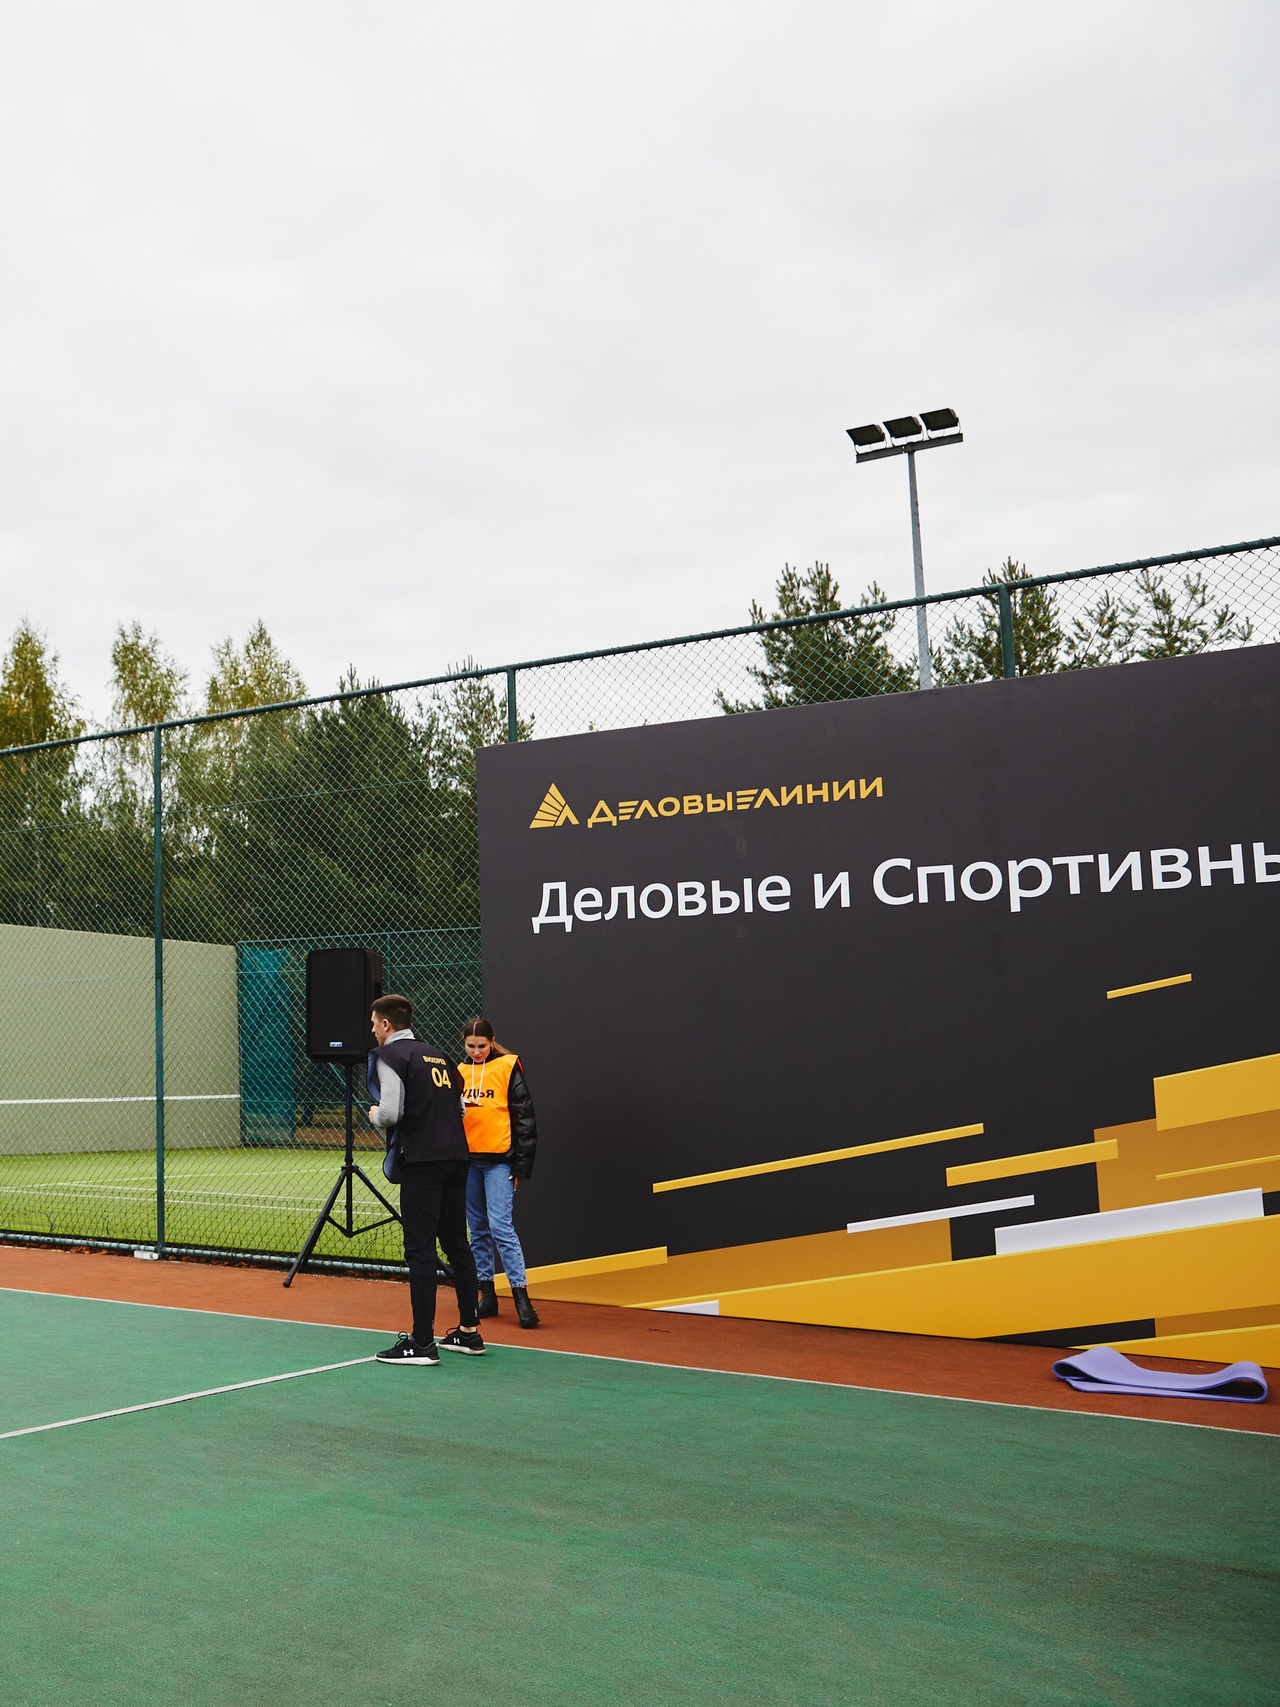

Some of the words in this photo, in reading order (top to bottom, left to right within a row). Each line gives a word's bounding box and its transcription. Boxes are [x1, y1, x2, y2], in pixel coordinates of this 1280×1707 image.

[532, 876, 791, 933] Деловые
[814, 872, 851, 909] и
[431, 1067, 452, 1089] 04
[462, 1088, 495, 1100] УДЬЯ
